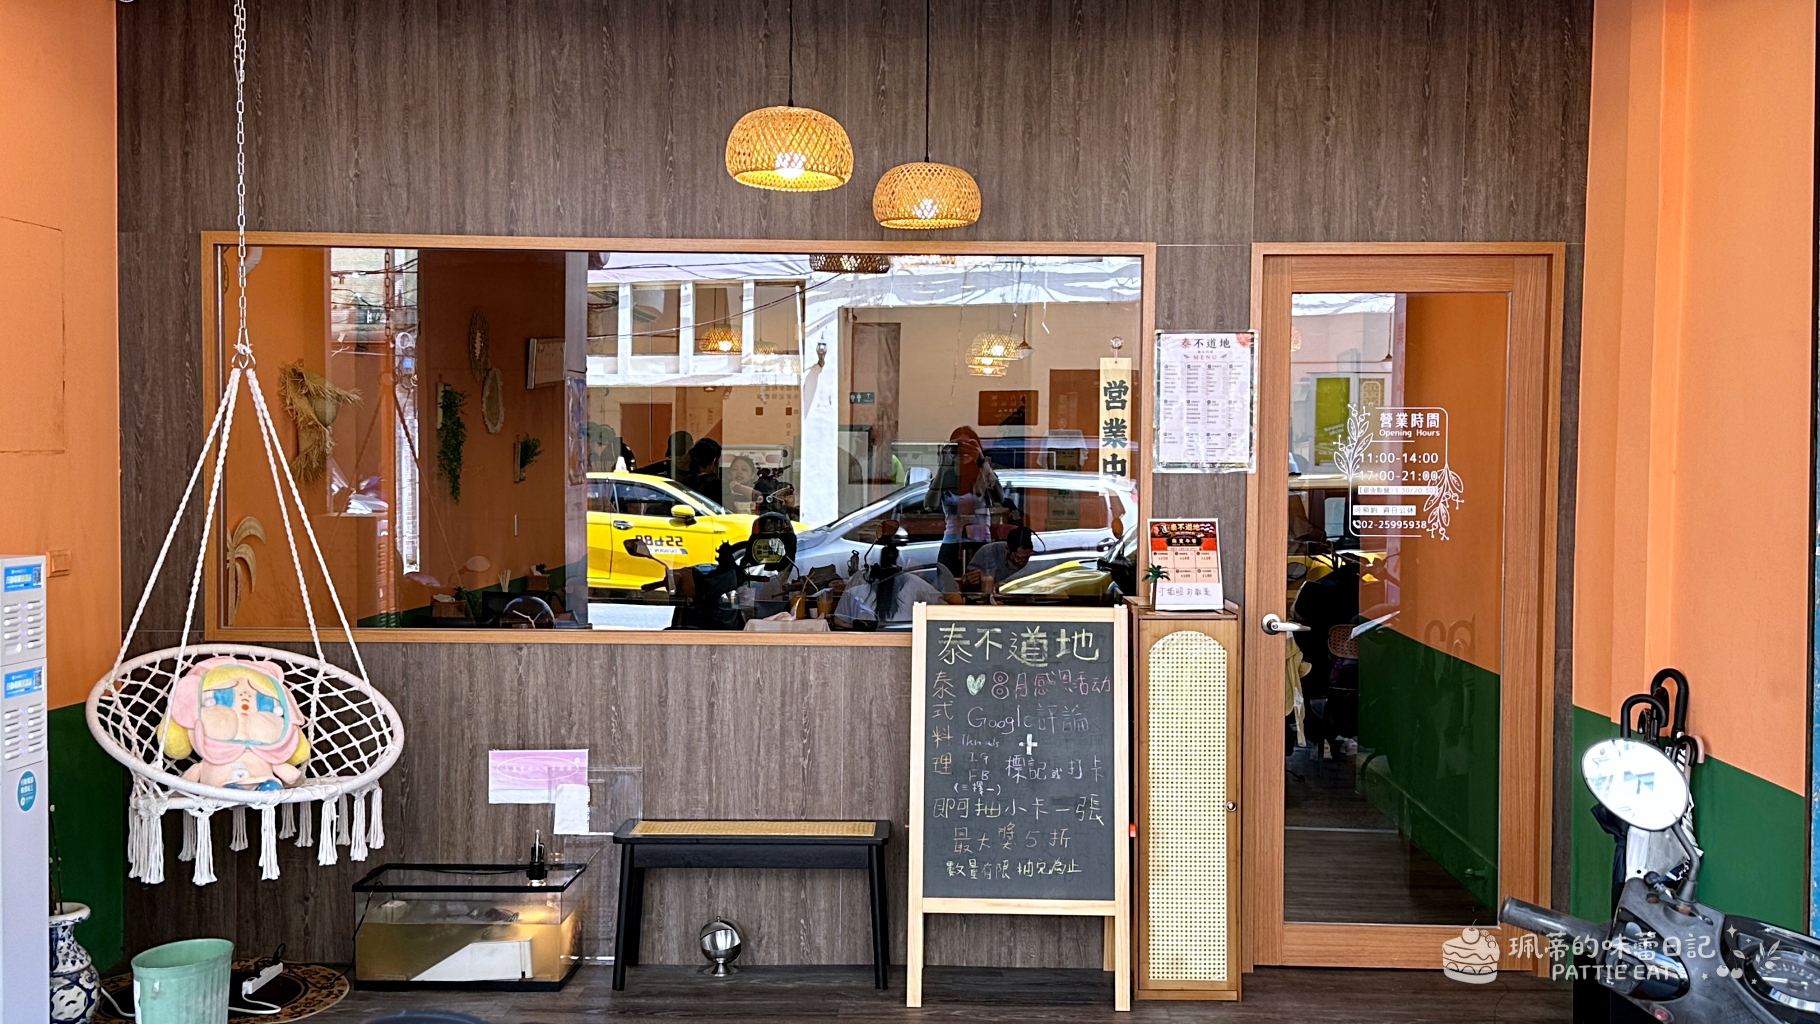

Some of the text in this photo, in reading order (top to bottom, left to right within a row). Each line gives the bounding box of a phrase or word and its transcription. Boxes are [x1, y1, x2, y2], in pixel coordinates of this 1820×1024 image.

[1181, 337, 1231, 349] 泰不道地
[1380, 412, 1440, 428] 營業時間
[1379, 429, 1440, 438] Opening Hours
[1360, 452, 1439, 464] 11:00-14:00
[1360, 470, 1438, 481] 17:00-21:00
[1361, 520, 1427, 529] 02-25995938
[938, 623, 1100, 667] 泰不道地
[932, 670, 956, 775] 泰式料理
[968, 769, 990, 782] FB
[933, 794, 1105, 826] 即可抽小卡一張
